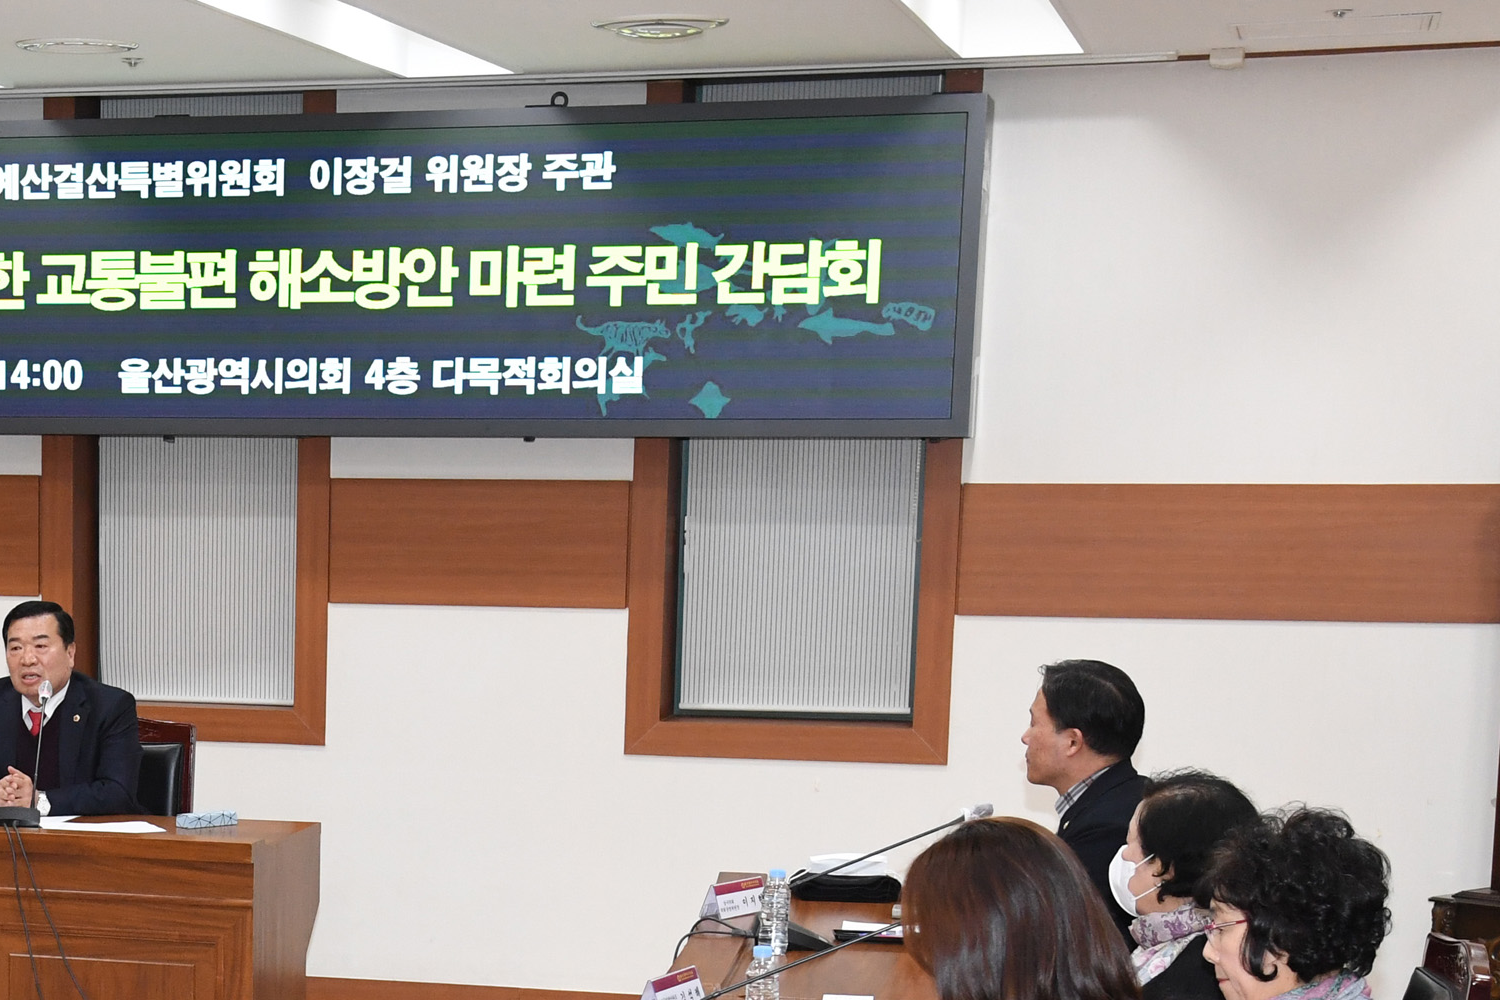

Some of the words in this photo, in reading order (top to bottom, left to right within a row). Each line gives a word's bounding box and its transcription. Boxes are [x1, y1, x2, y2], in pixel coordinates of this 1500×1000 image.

[309, 155, 412, 196] 이장걸
[425, 152, 533, 194] 위원장
[542, 150, 617, 192] 주관
[36, 249, 237, 312] 교통불편
[248, 246, 460, 310] 해소방안
[469, 244, 577, 308] 마련
[586, 242, 699, 307] 주민
[711, 238, 882, 305] 간담회
[117, 357, 352, 395] 울산광역시의회
[364, 356, 421, 395] 4층
[432, 355, 644, 396] 다목적회의실
